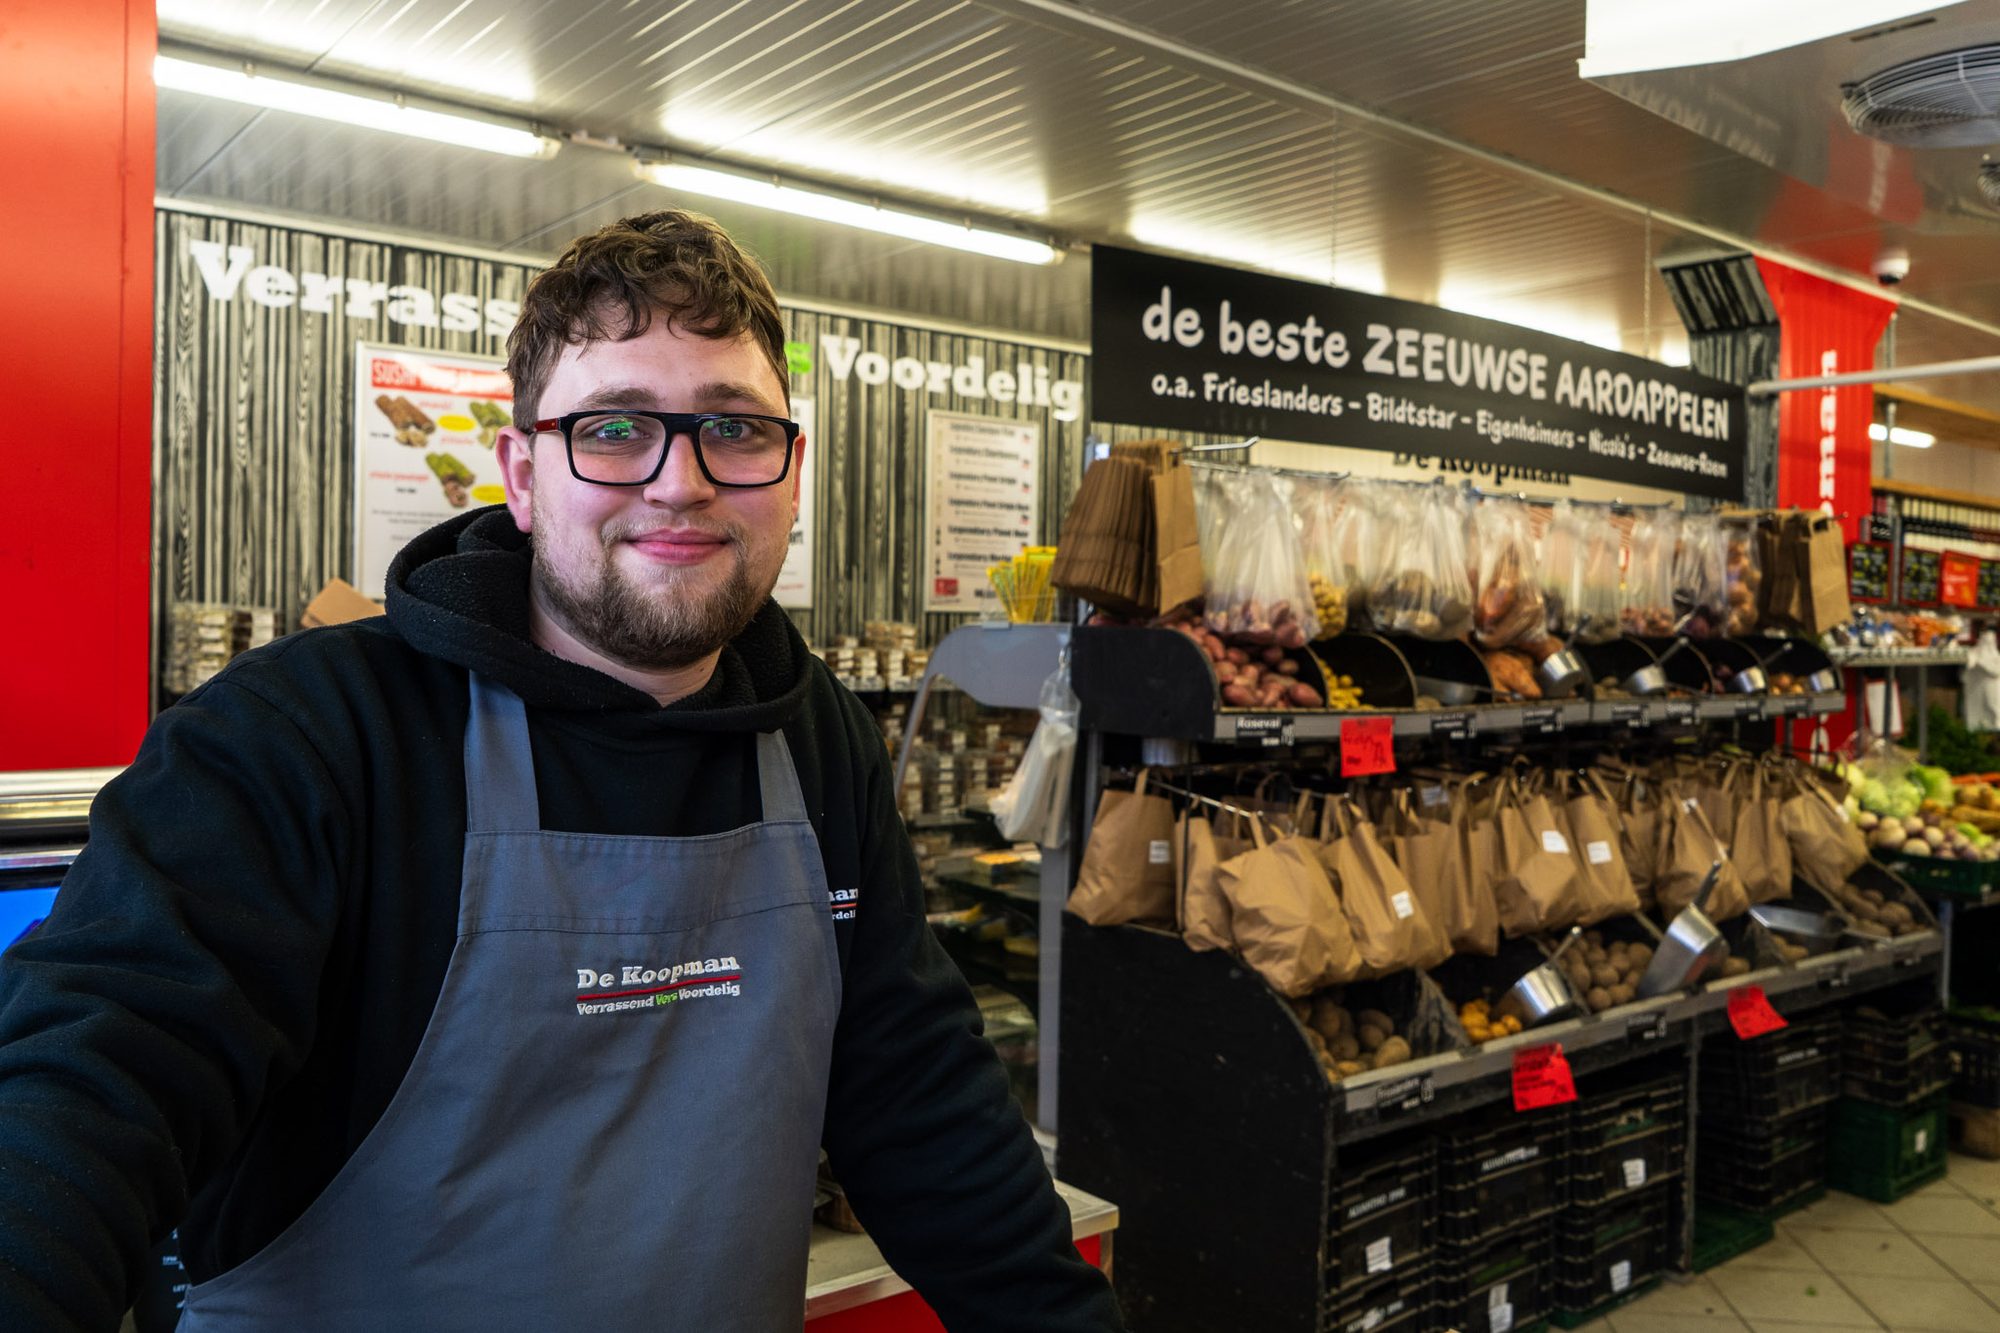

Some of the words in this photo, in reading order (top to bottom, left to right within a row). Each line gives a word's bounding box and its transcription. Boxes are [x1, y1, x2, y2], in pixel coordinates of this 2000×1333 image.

[819, 334, 1084, 421] Voordelig
[1142, 285, 1204, 348] de
[1219, 299, 1350, 369] beste
[1362, 323, 1548, 400] ZEEUWSE
[1554, 360, 1730, 441] AARDAPPELEN
[1151, 373, 1196, 399] o.a.
[1202, 372, 1344, 417] Frieslanders
[1366, 391, 1457, 430] Bildtstar
[1475, 408, 1576, 450] Eigenheimers
[576, 996, 655, 1016] Verrassend
[656, 992, 678, 1006] Vers
[678, 981, 741, 1001] Voordelig
[577, 968, 615, 989] De
[621, 956, 742, 986] Koopman
